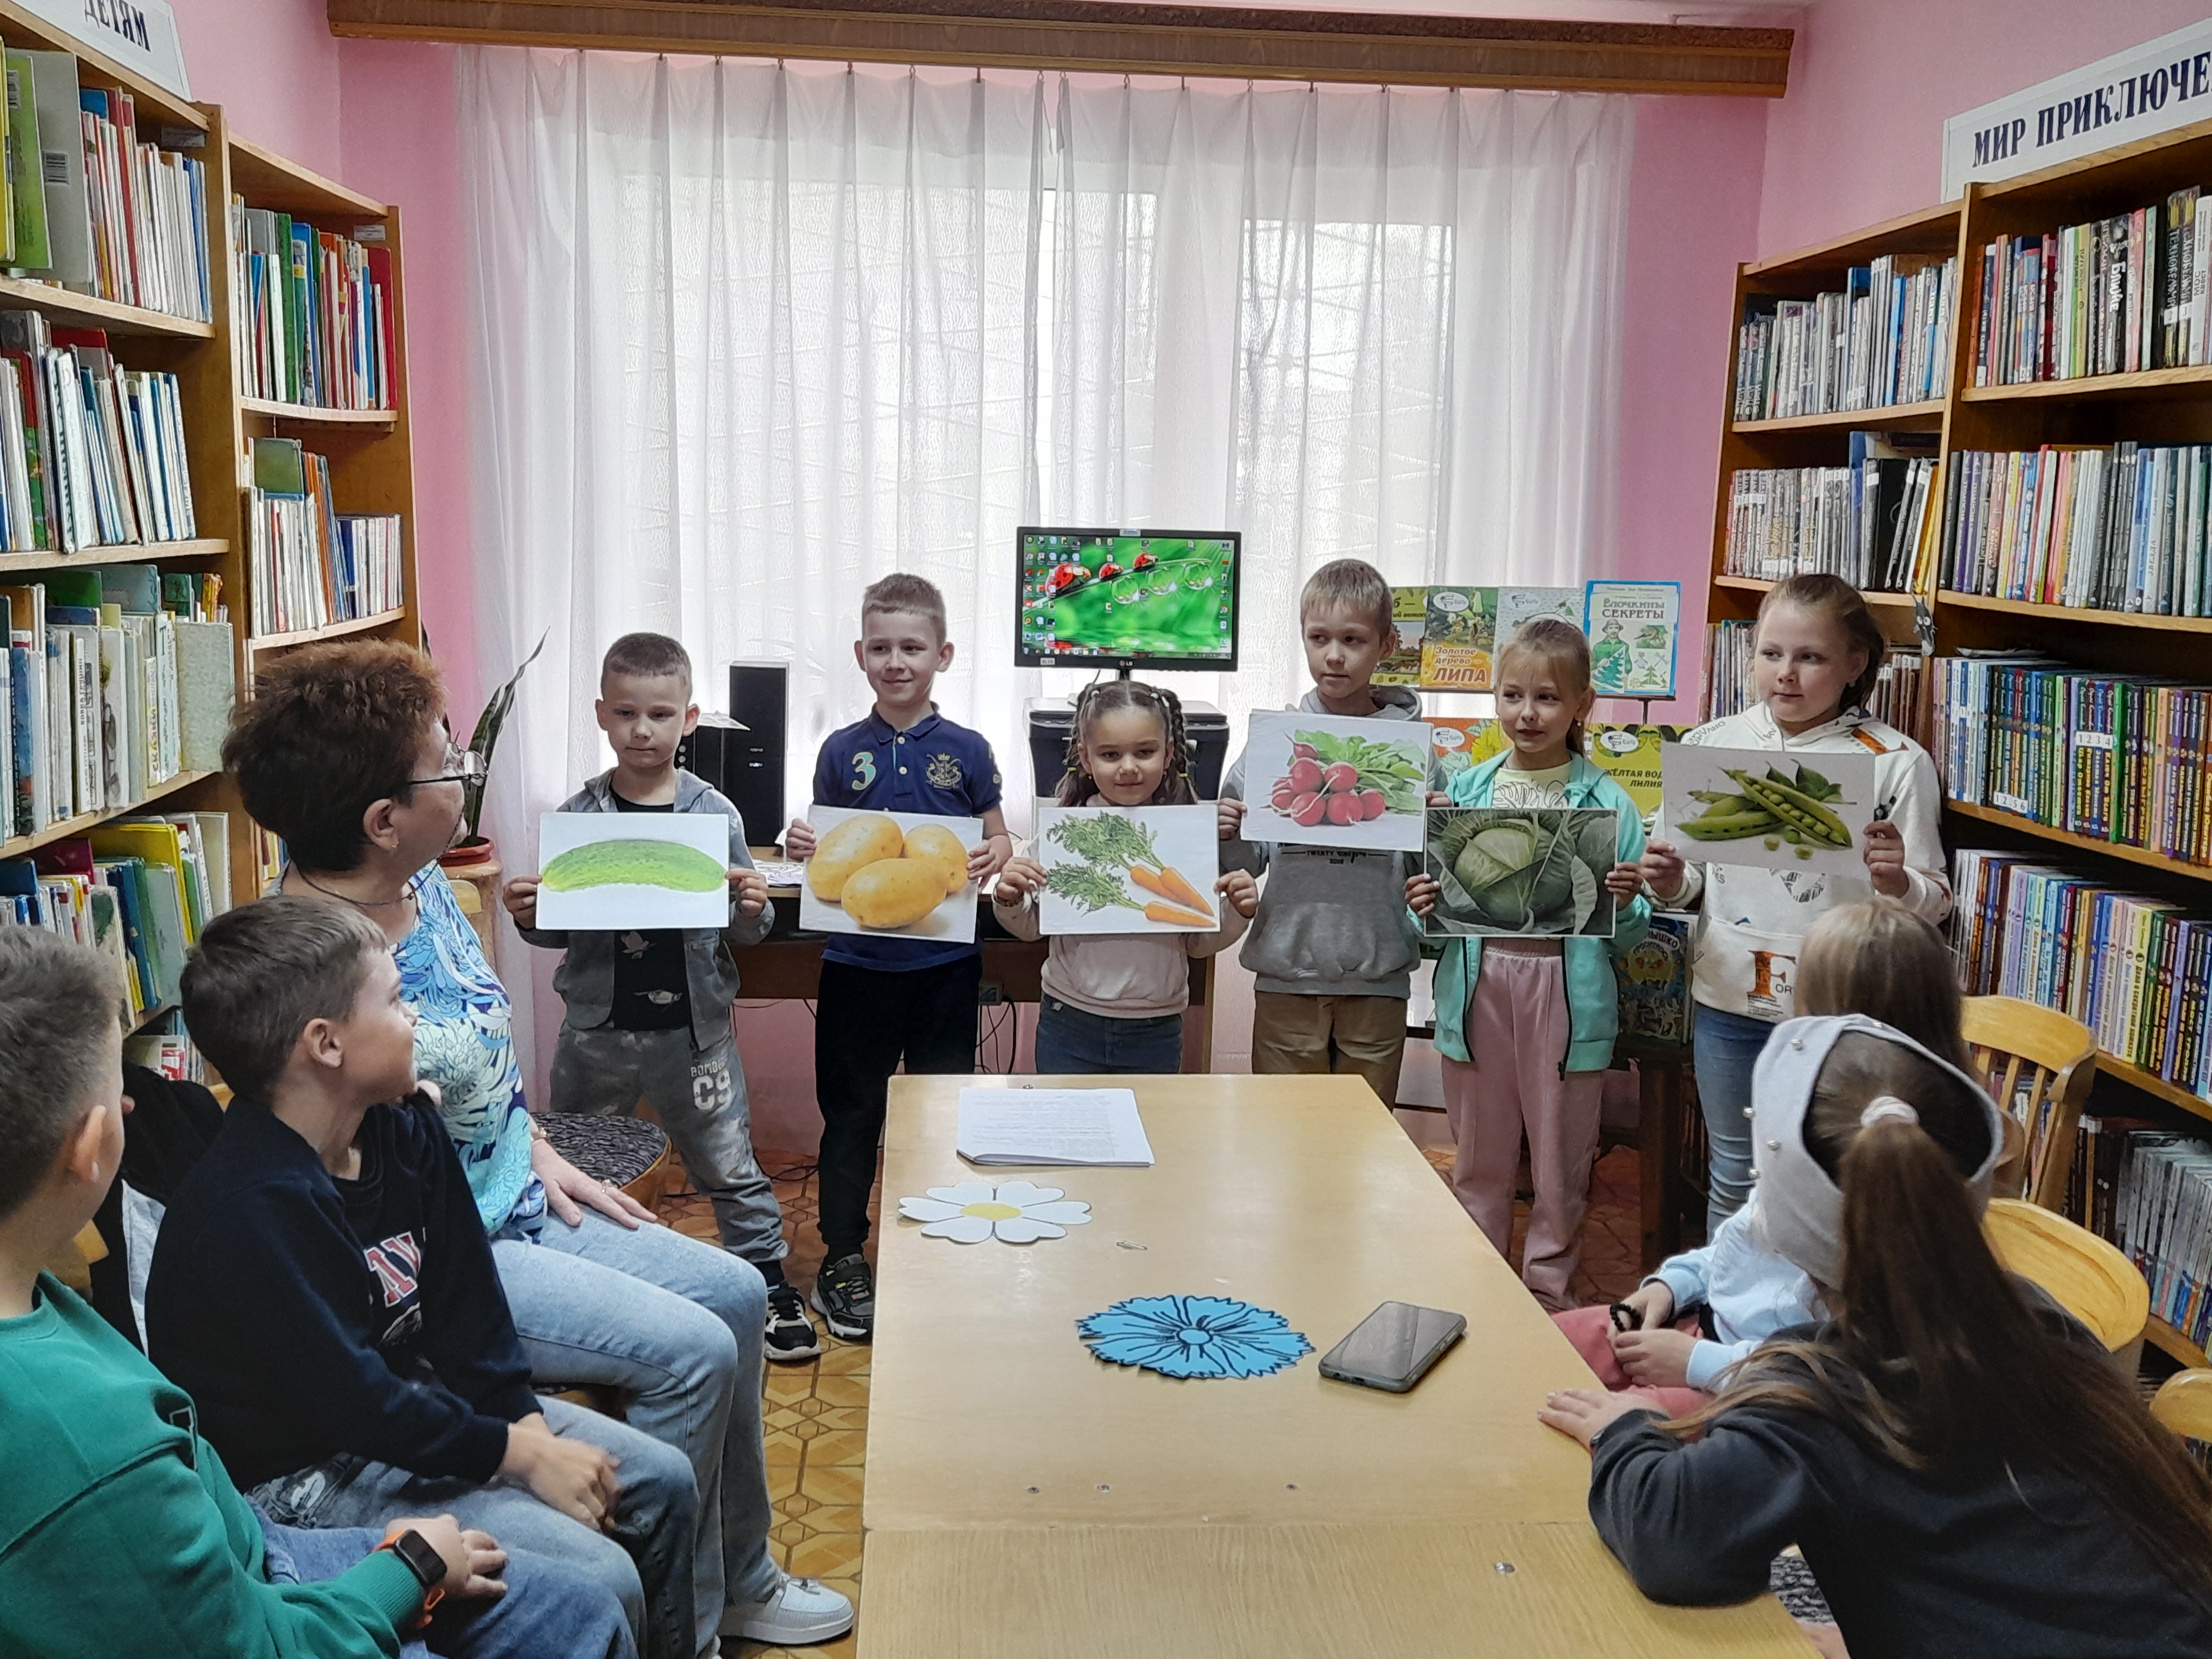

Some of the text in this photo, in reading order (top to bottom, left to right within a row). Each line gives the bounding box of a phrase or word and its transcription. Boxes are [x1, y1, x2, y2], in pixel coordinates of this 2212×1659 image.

[1973, 50, 2212, 169] МИР ПРИКЛЮЧЕ
[1602, 609, 1664, 619] СЕКРЕТЫ
[1435, 646, 1476, 656] Золотое
[1434, 657, 1470, 665] дерево
[1433, 668, 1487, 683] ЛИПА
[852, 751, 877, 791] 3
[1630, 780, 1663, 788] ЛИЛИЯ
[693, 1070, 733, 1112] C9
